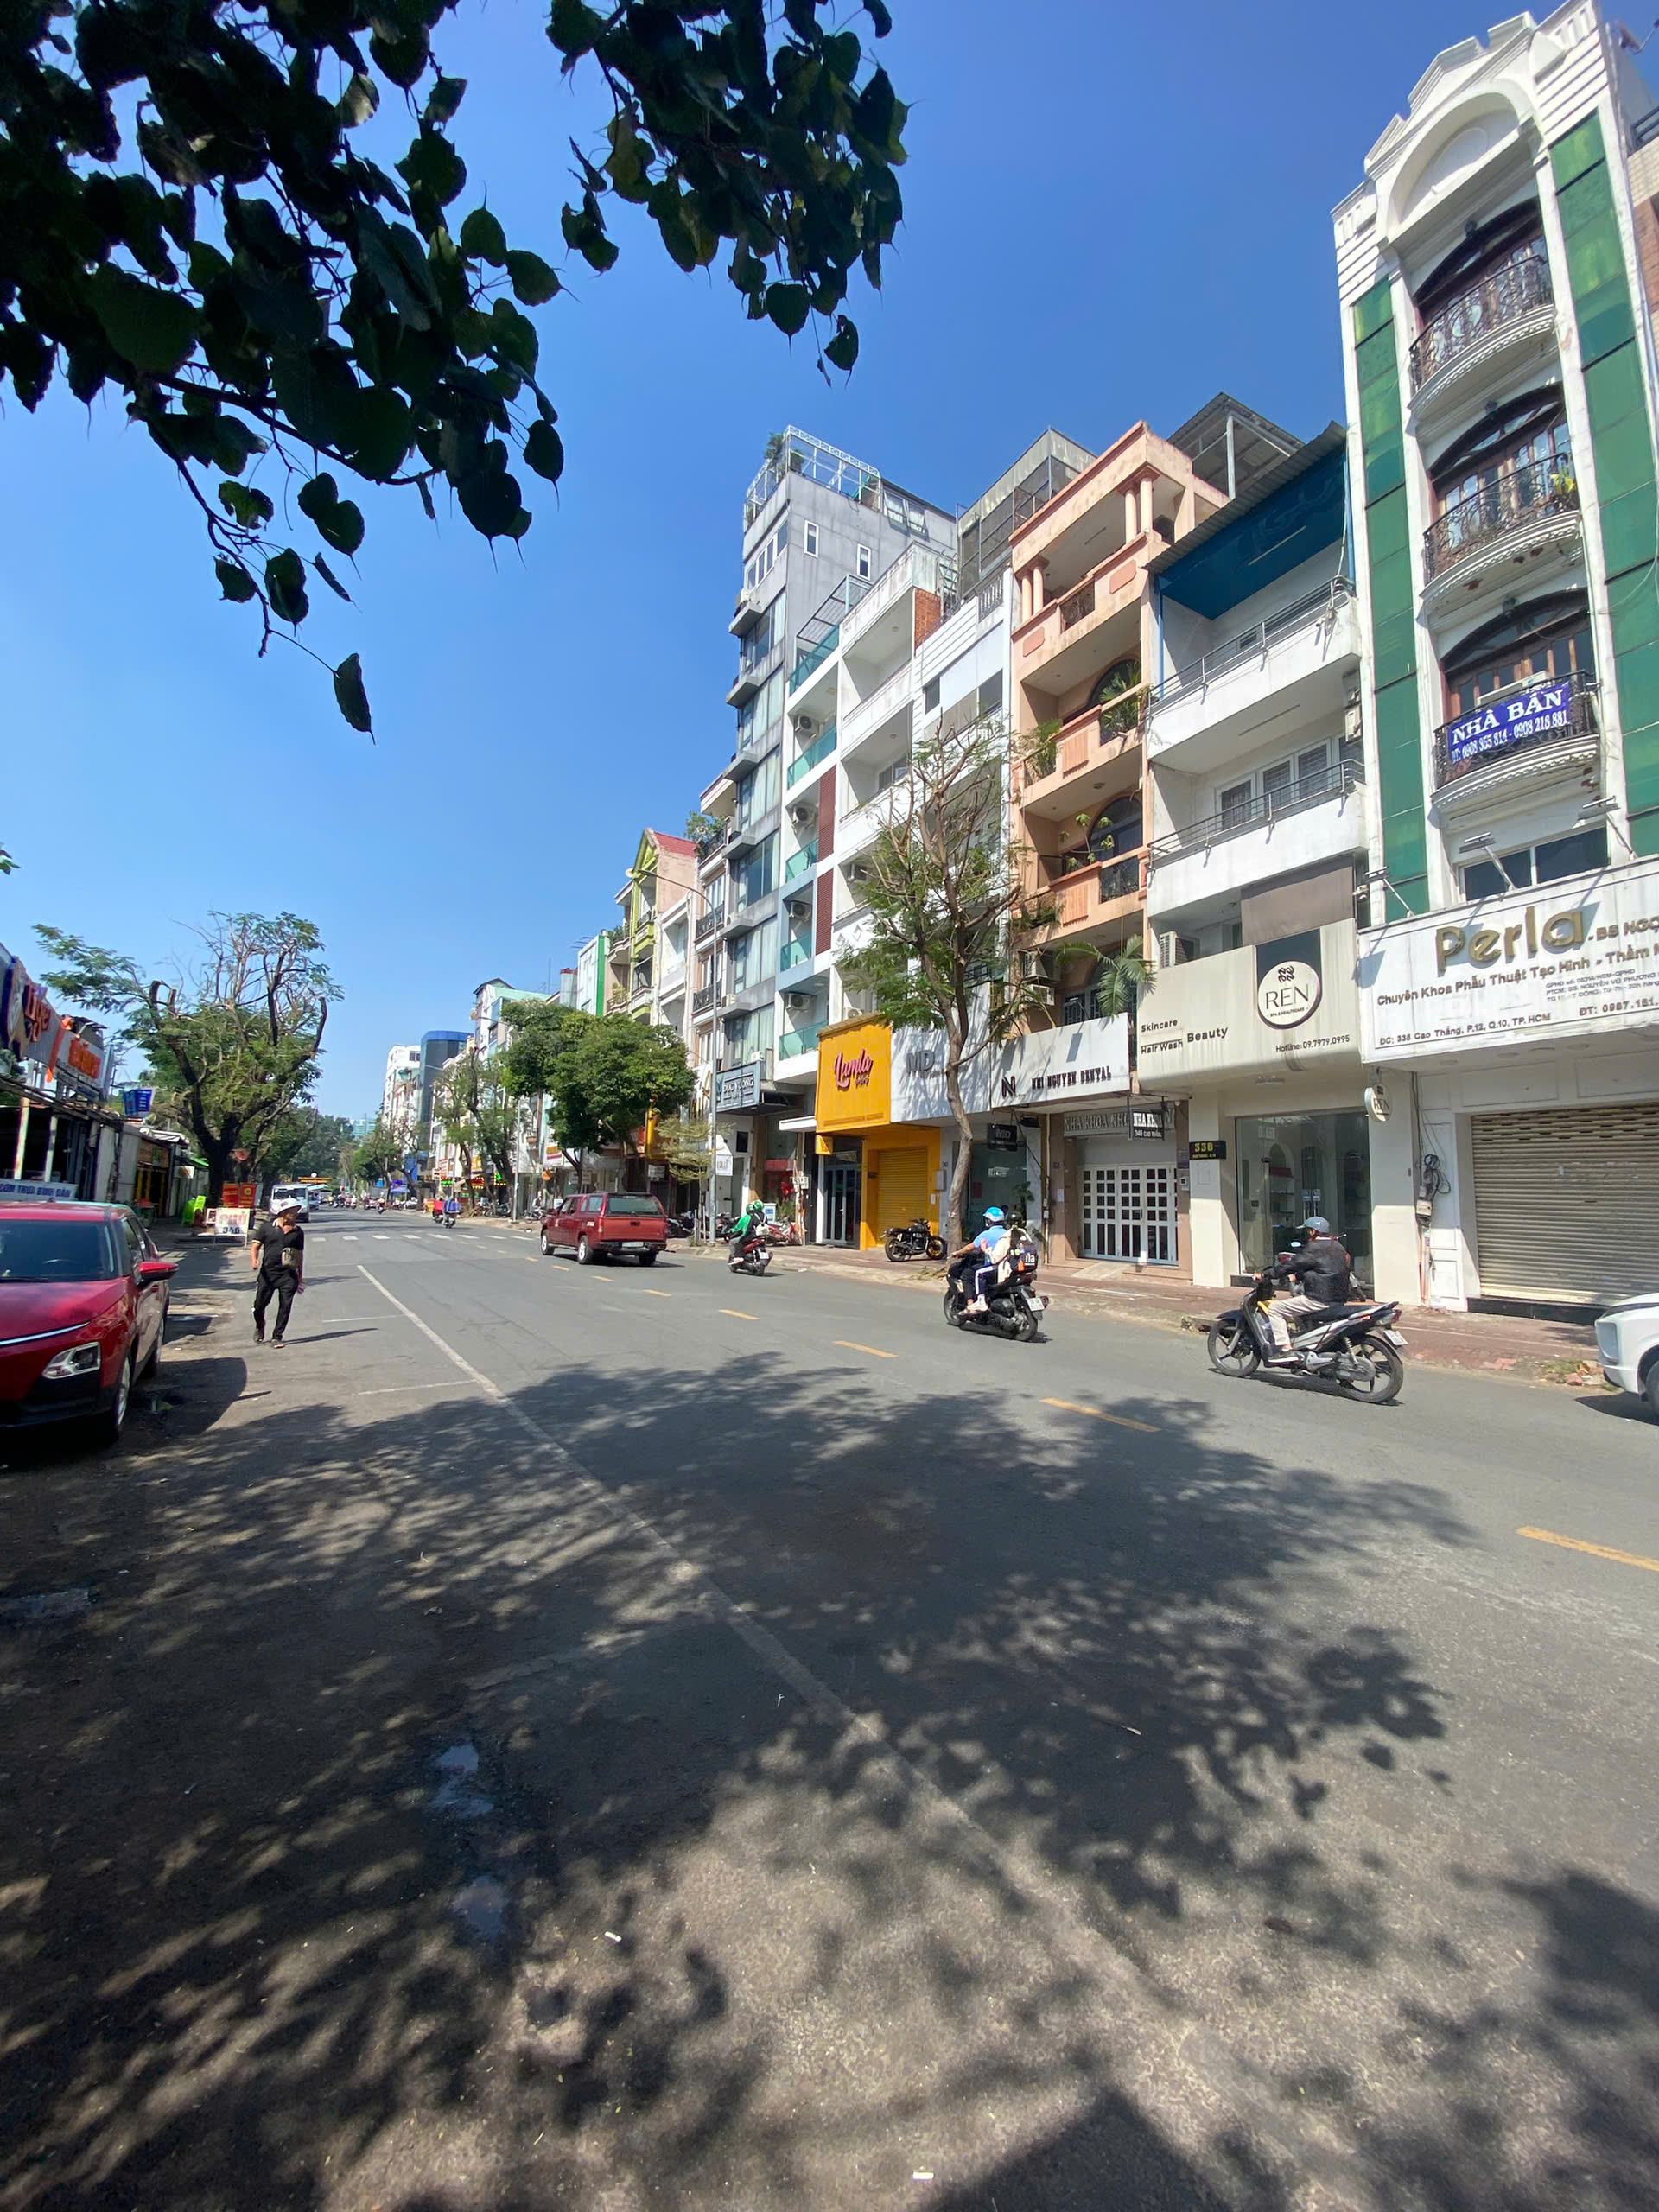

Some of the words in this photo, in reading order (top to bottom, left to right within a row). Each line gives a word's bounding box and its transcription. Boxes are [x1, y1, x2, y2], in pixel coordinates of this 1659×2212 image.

[1452, 709, 1500, 746] NHÀ
[1507, 689, 1564, 722] BÁN
[1436, 905, 1585, 976] Perla
[1377, 989, 1418, 1006] Chuyên
[1421, 985, 1452, 999] Khoa
[1455, 975, 1486, 993] Phẫu
[1490, 969, 1528, 985] Thuật
[1530, 964, 1555, 980] Tạo
[1559, 957, 1590, 974] Hình
[1265, 983, 1310, 1010] REN
[1141, 1019, 1178, 1033] Skincare
[1186, 1027, 1229, 1043] Beauty
[1414, 1032, 1432, 1041] Cao
[1528, 1012, 1552, 1025] HCM
[1141, 1046, 1158, 1054] Hair
[1160, 1040, 1184, 1052] Wash
[1302, 1034, 1351, 1049] 09.7979.0995
[1080, 1065, 1112, 1085] DENTAL
